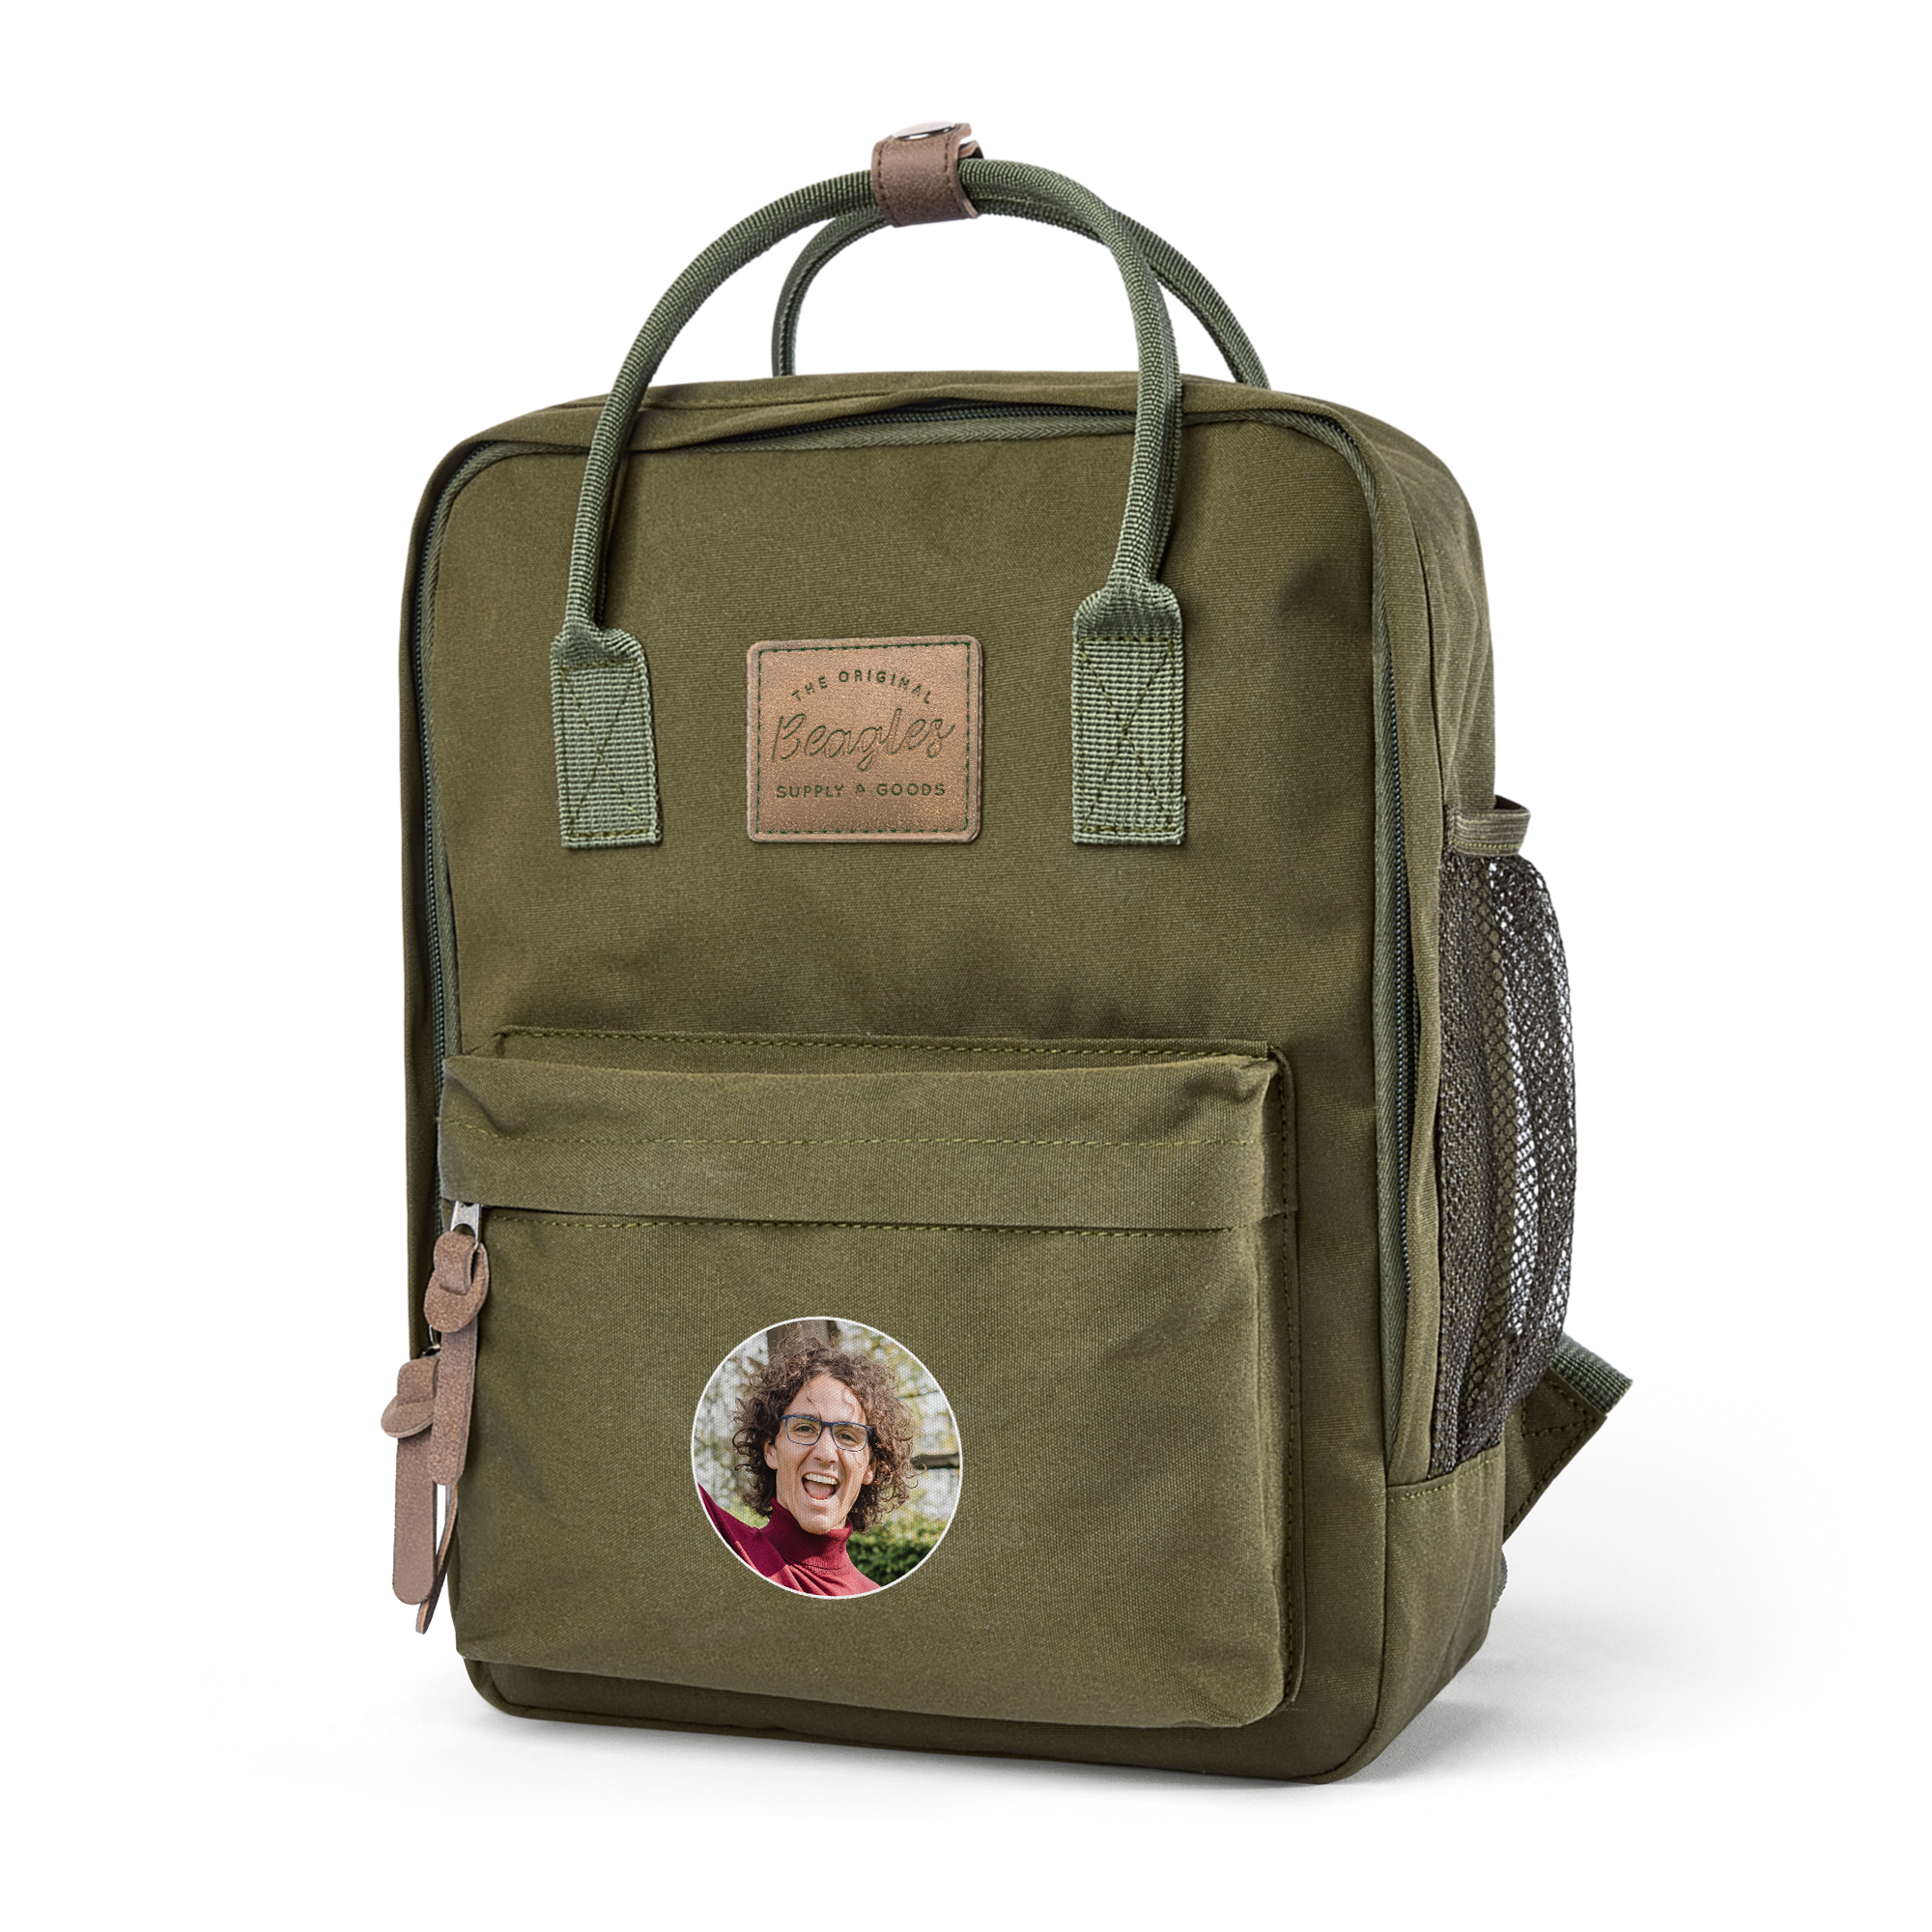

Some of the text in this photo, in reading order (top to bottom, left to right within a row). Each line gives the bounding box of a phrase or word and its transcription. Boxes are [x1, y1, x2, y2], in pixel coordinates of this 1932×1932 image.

[791, 669, 931, 704] THE ORIGINAL
[772, 708, 955, 772] Beagles
[776, 784, 844, 799] SUPPLY
[876, 783, 946, 797] GOODS
